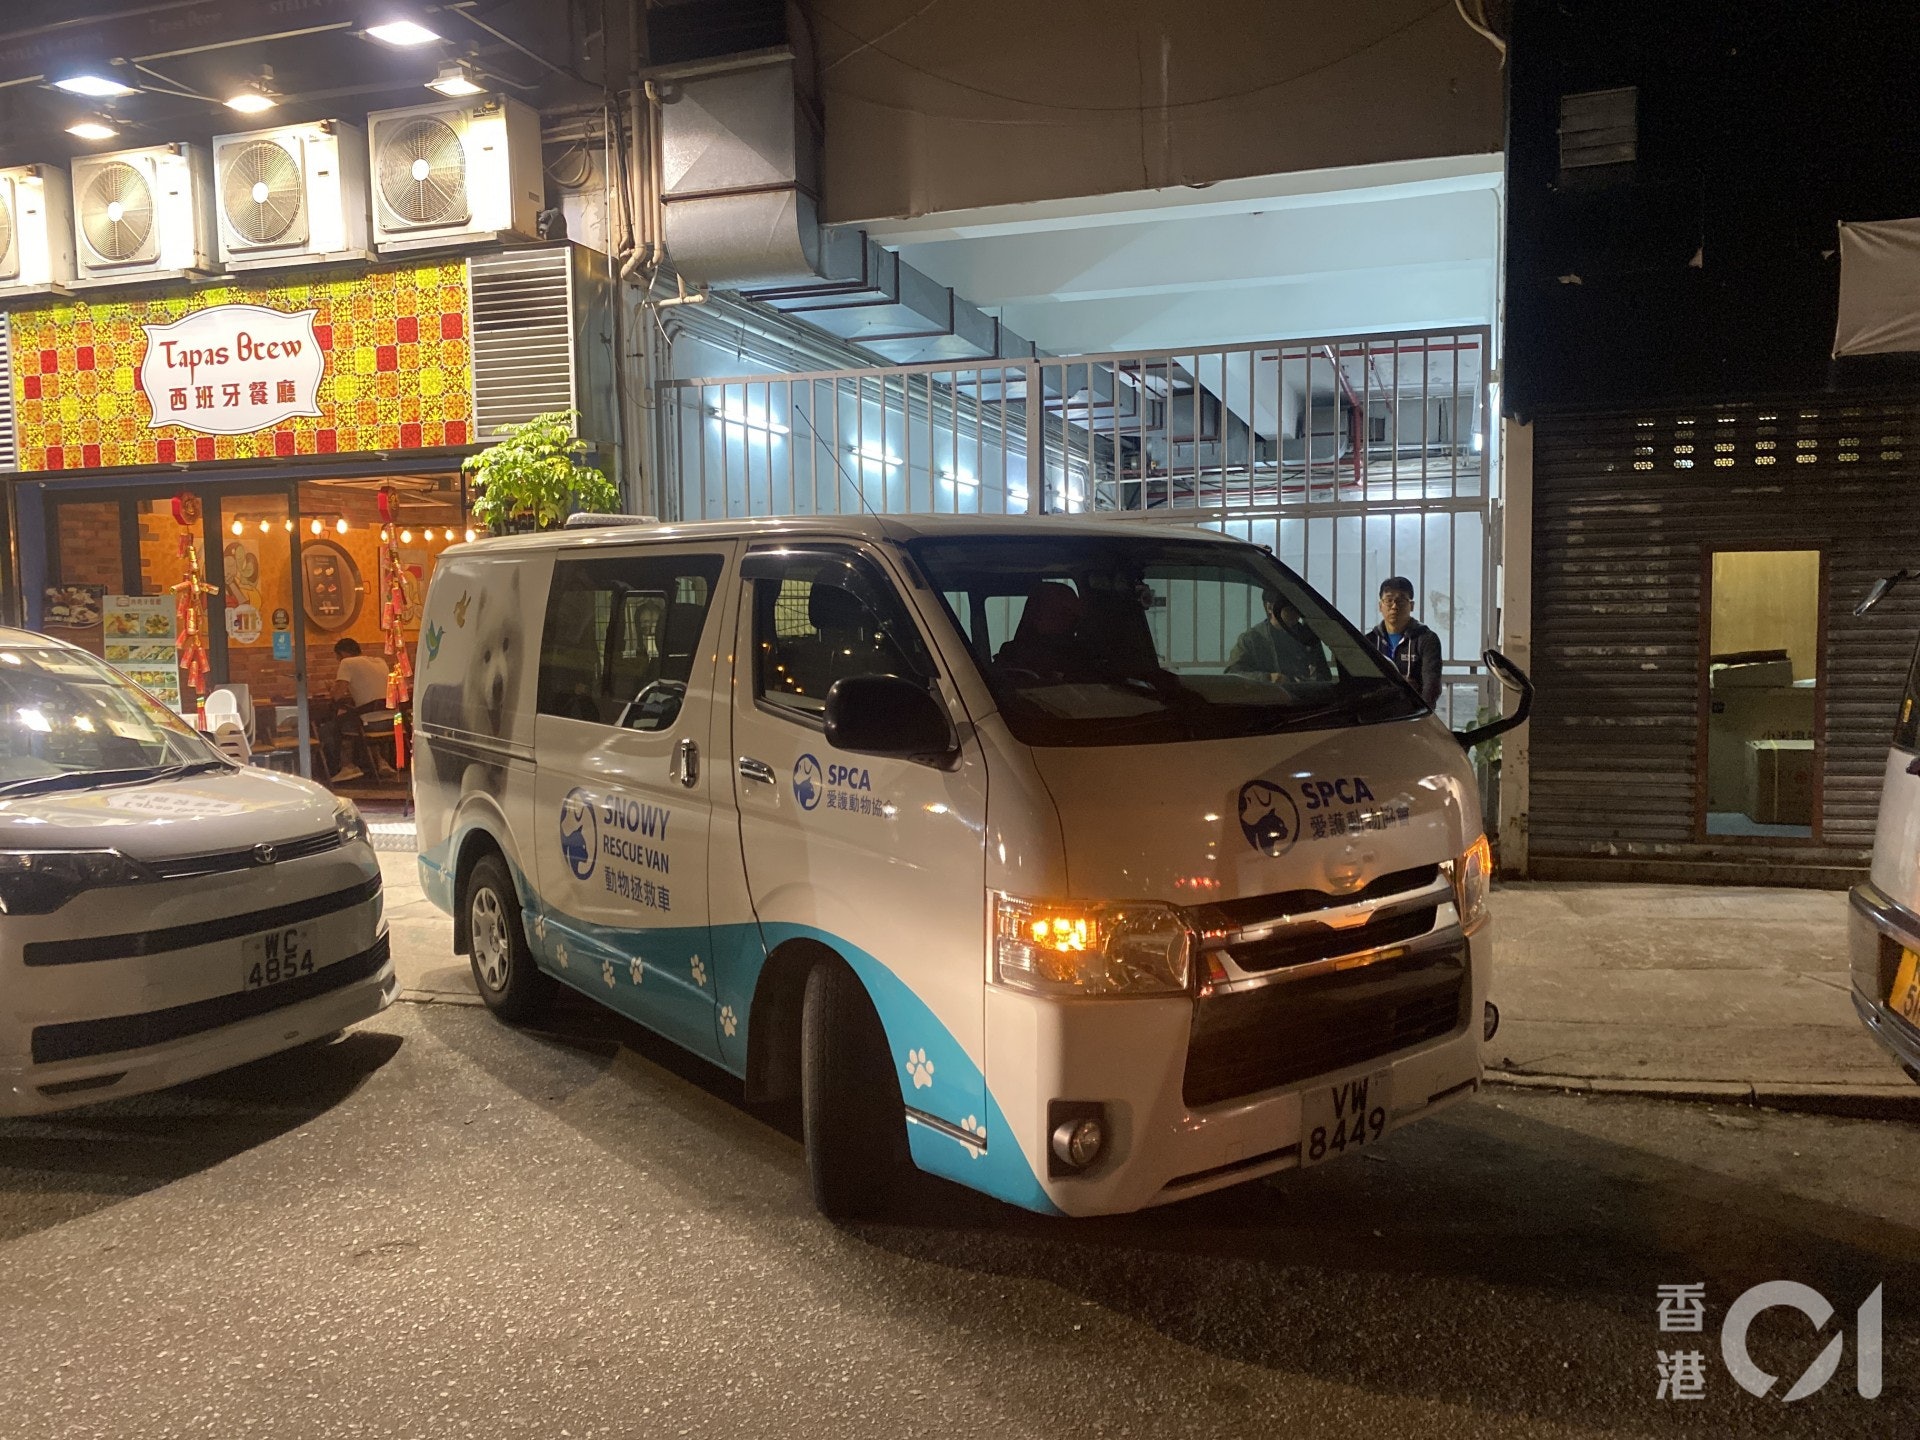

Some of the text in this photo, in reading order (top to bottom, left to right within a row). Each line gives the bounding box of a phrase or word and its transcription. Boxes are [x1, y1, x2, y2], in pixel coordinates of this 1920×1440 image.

[159, 331, 303, 386] Tapas Brew
[168, 379, 297, 411] 西班牙餐廳
[827, 764, 871, 792] SPCA
[1300, 777, 1375, 810] SPCA
[603, 794, 671, 841] SNOWY
[603, 834, 669, 874] RESCUE VAN
[604, 865, 671, 913] 動物拯救車
[265, 929, 298, 959] WC
[248, 949, 315, 987] 4854
[1331, 1076, 1369, 1120] VW
[1308, 1105, 1386, 1161] 8449
